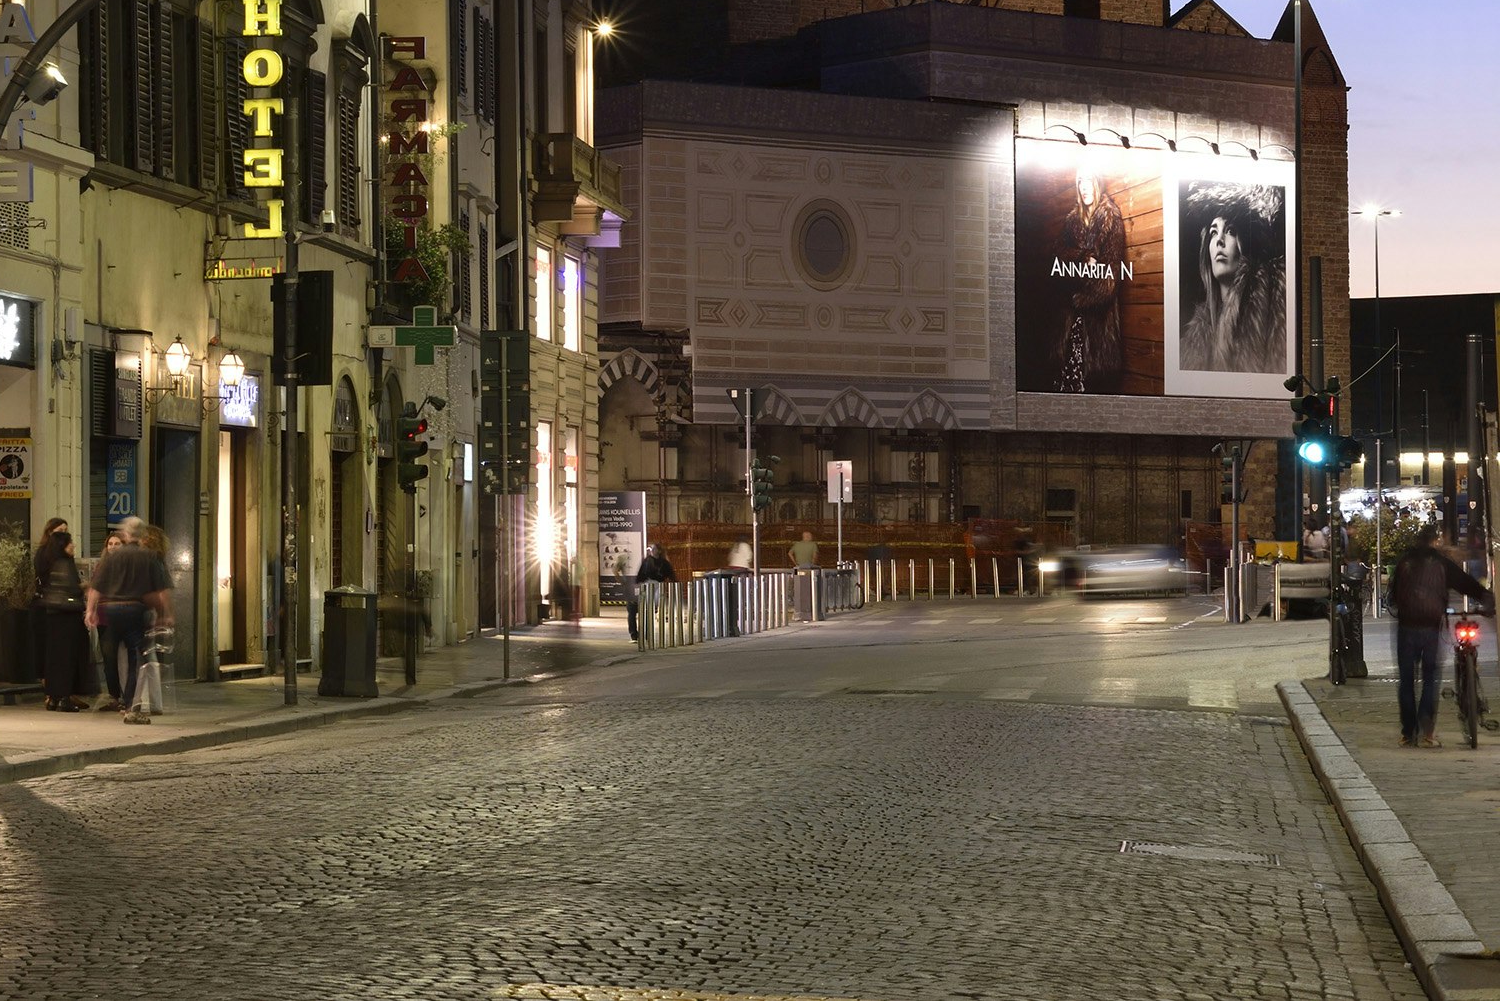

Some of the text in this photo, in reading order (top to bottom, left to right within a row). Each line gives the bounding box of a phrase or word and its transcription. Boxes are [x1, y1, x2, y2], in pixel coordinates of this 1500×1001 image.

[1050, 256, 1133, 280] ANNARITA N
[610, 508, 641, 516] KOUNELLIS
